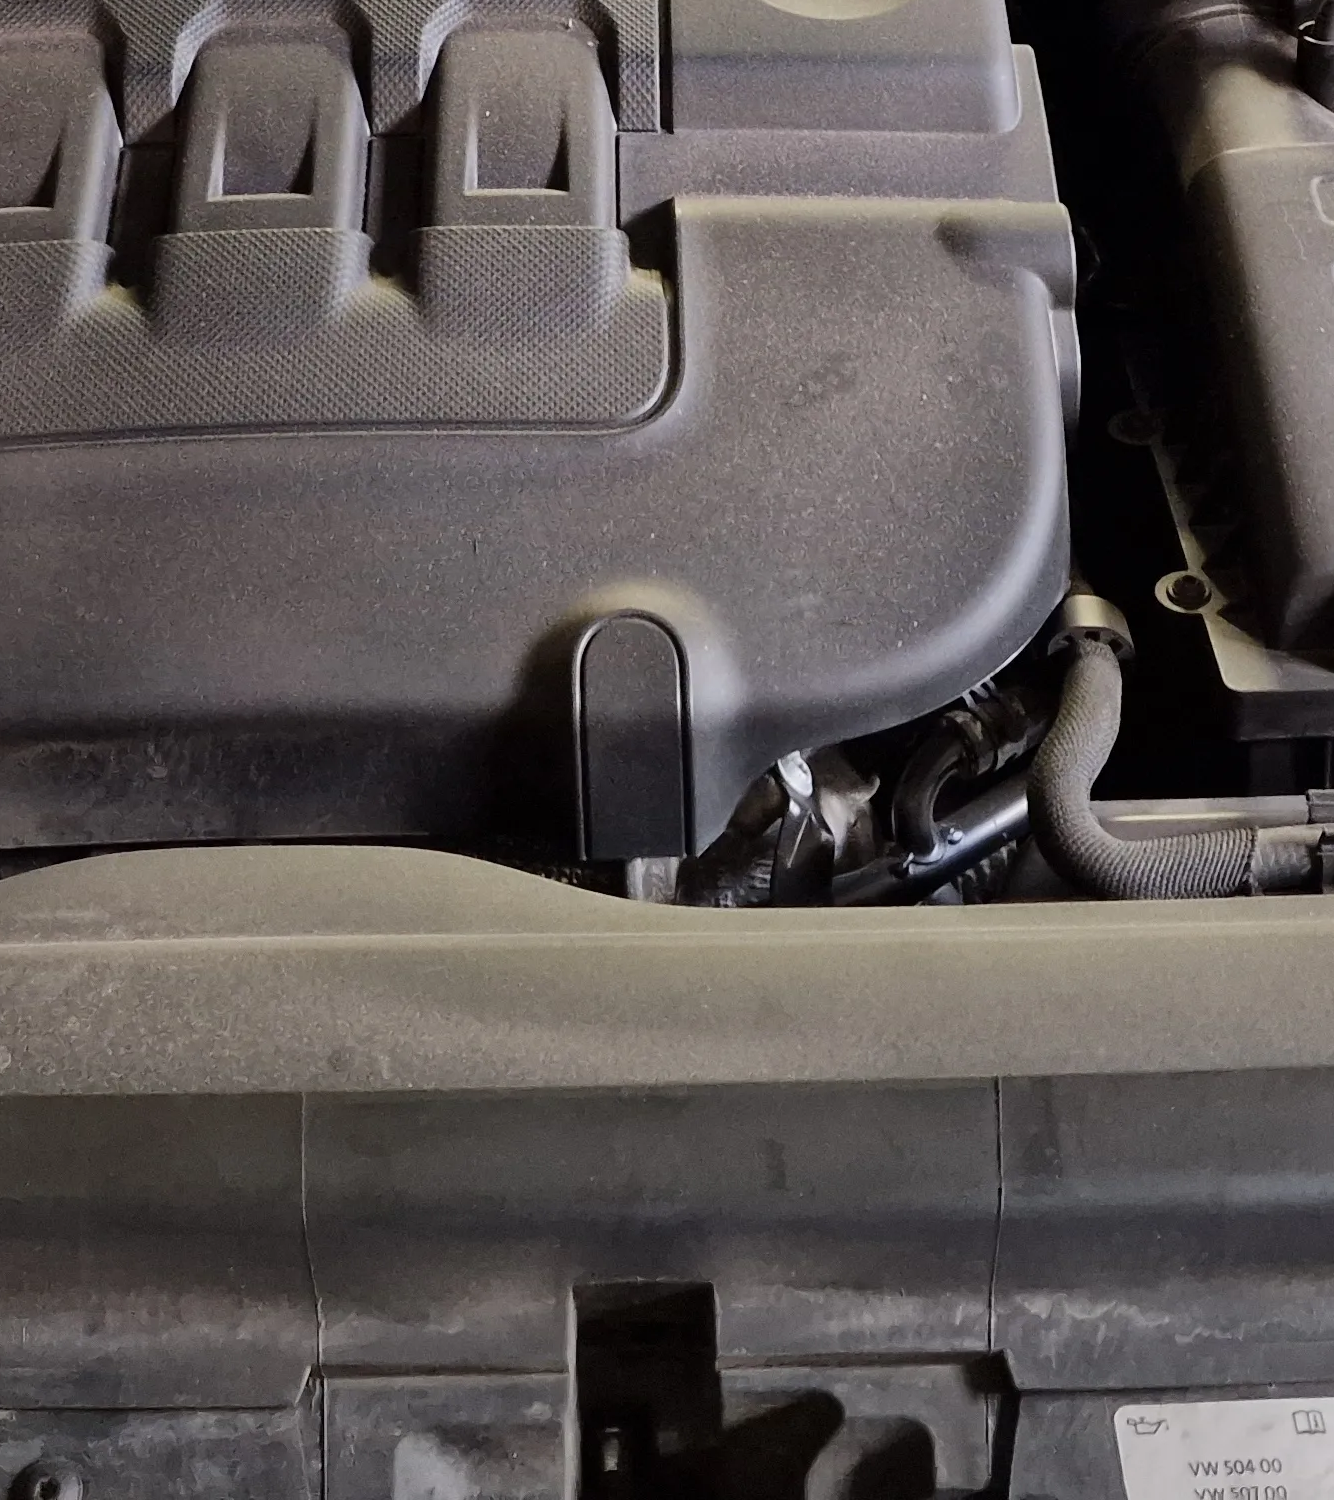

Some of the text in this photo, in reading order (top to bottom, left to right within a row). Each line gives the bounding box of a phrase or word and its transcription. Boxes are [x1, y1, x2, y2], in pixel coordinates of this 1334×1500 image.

[1188, 1457, 1283, 1476] VW 504 00
[1194, 1487, 1224, 1500] VW
